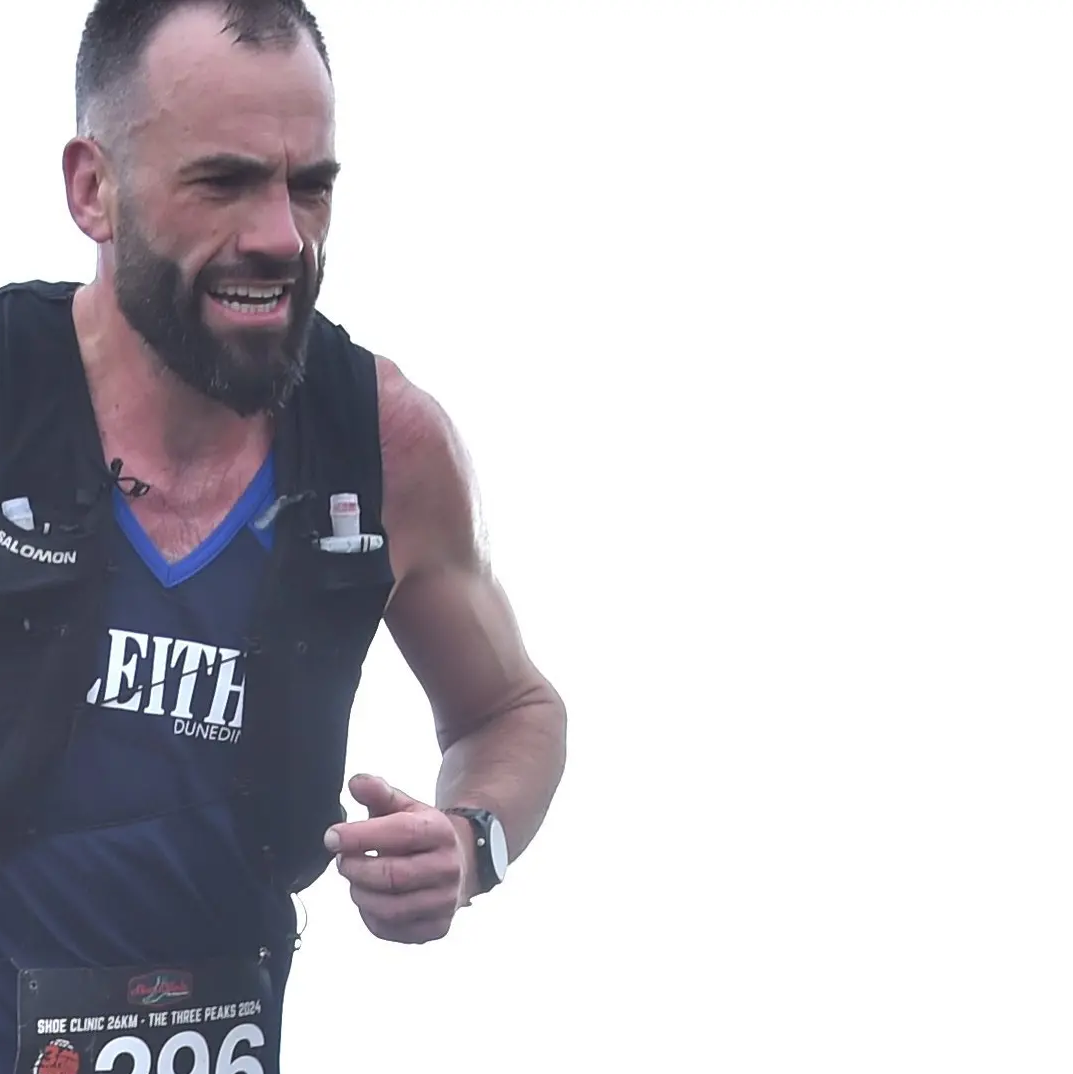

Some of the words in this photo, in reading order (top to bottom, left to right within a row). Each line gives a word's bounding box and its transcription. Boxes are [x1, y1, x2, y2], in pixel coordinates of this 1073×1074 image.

[85, 628, 246, 728] EITH
[37, 1018, 68, 1034] SHOE
[69, 1016, 105, 1032] CLINIC
[106, 1013, 139, 1030] 26KM
[148, 1010, 169, 1027] THE
[170, 1007, 203, 1025] THREE
[204, 1003, 236, 1021] PEAKS
[237, 999, 262, 1017] 2024
